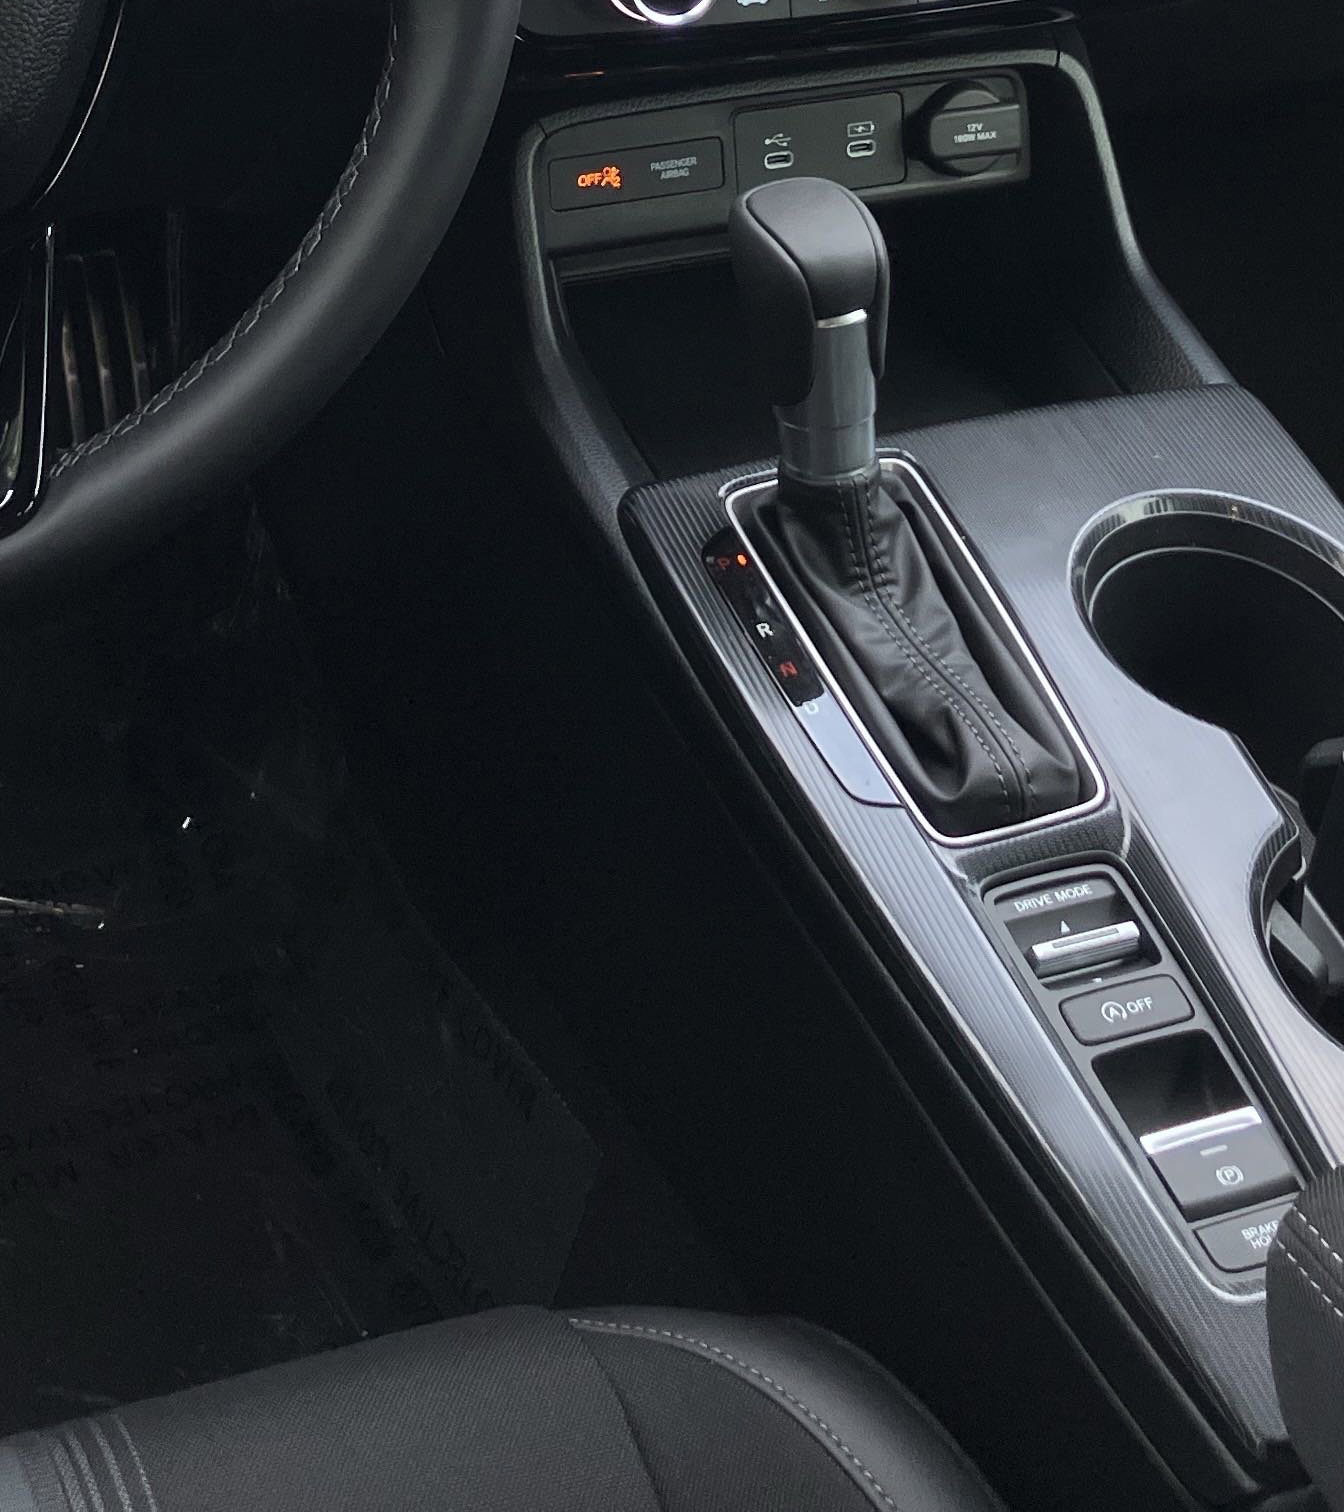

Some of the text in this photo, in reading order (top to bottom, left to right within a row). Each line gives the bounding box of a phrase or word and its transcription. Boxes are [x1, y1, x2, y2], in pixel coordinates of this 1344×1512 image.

[650, 156, 697, 172] PASSENGER
[577, 172, 602, 187] OFF
[660, 167, 690, 180] AIRBAG
[756, 622, 774, 638] R
[779, 660, 798, 677] N
[1014, 885, 1093, 913] DRIVE MODE
[1127, 997, 1153, 1014] OFF
